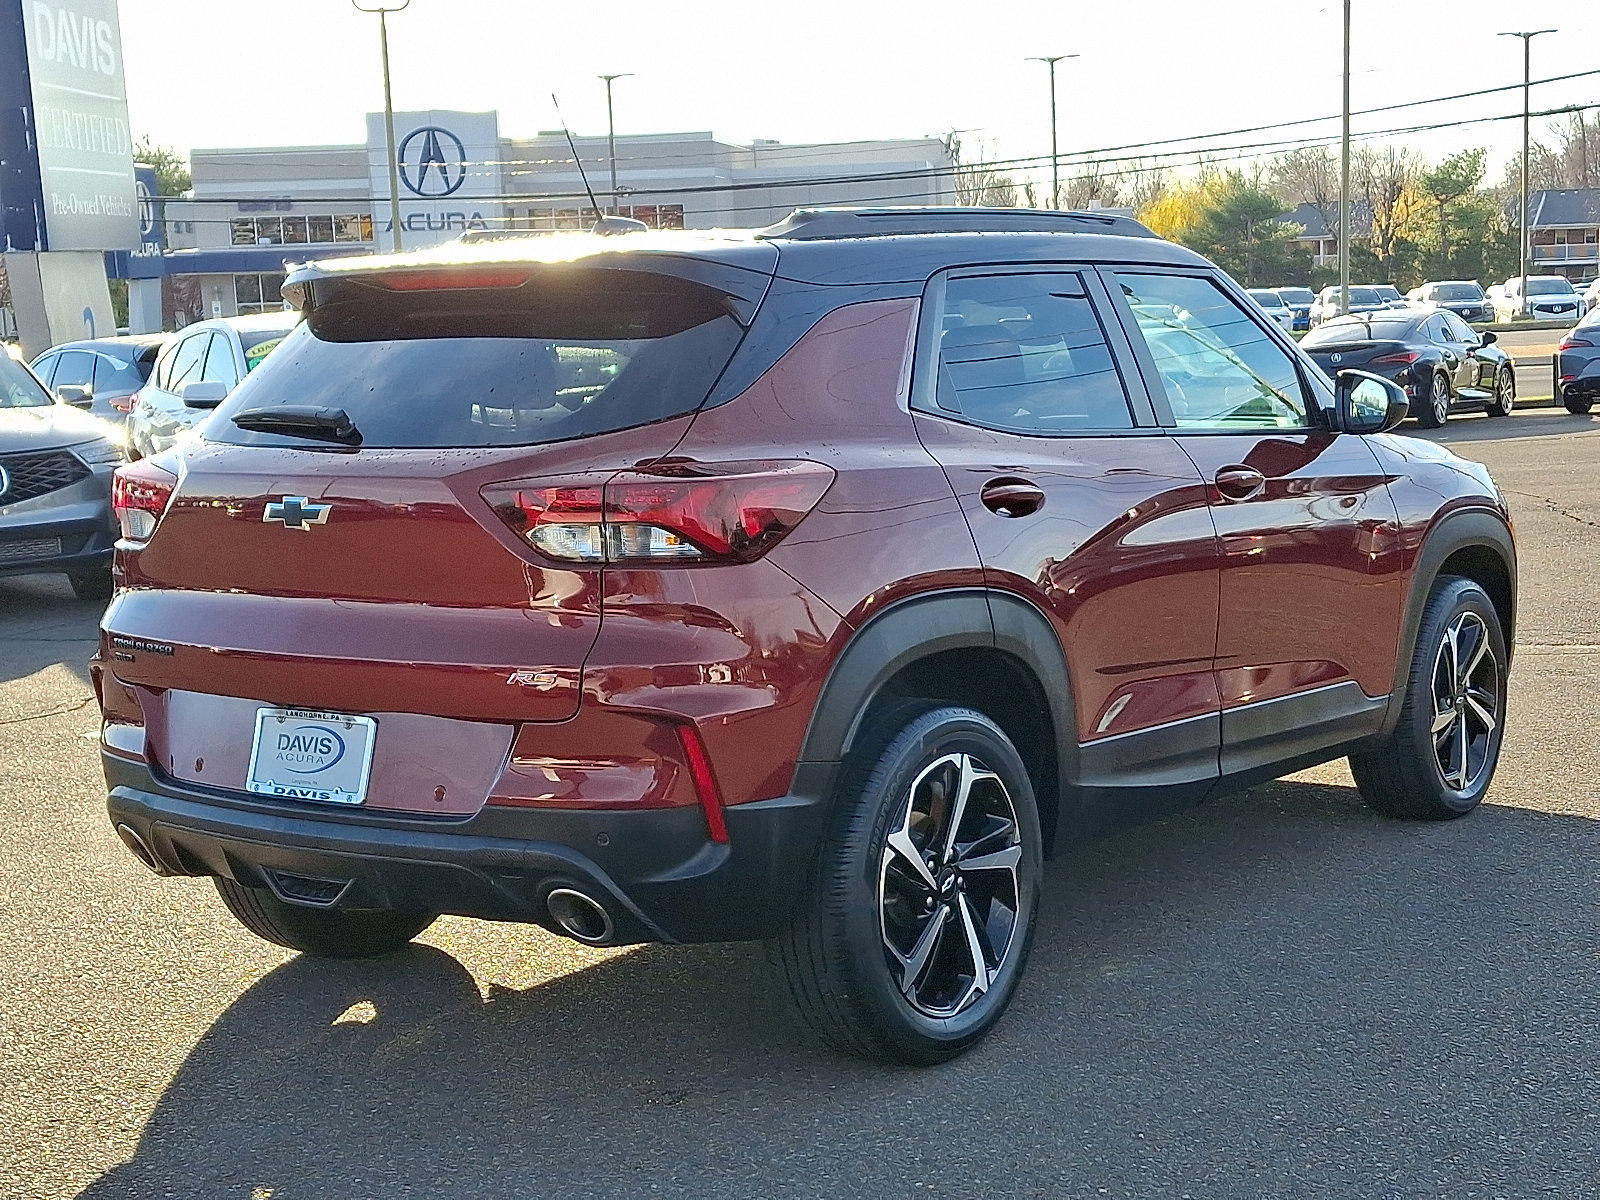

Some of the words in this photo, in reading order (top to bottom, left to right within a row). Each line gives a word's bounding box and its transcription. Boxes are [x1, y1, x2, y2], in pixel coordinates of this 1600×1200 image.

[32, 2, 116, 76] DAVIS
[40, 105, 128, 155] CERTIFIED
[52, 193, 99, 216] Pre-Owned
[100, 194, 132, 217] Vehicles
[506, 672, 558, 686] RS
[277, 733, 333, 755] DAVIS
[275, 752, 324, 765] ACURA
[273, 786, 331, 800] DAVIS
